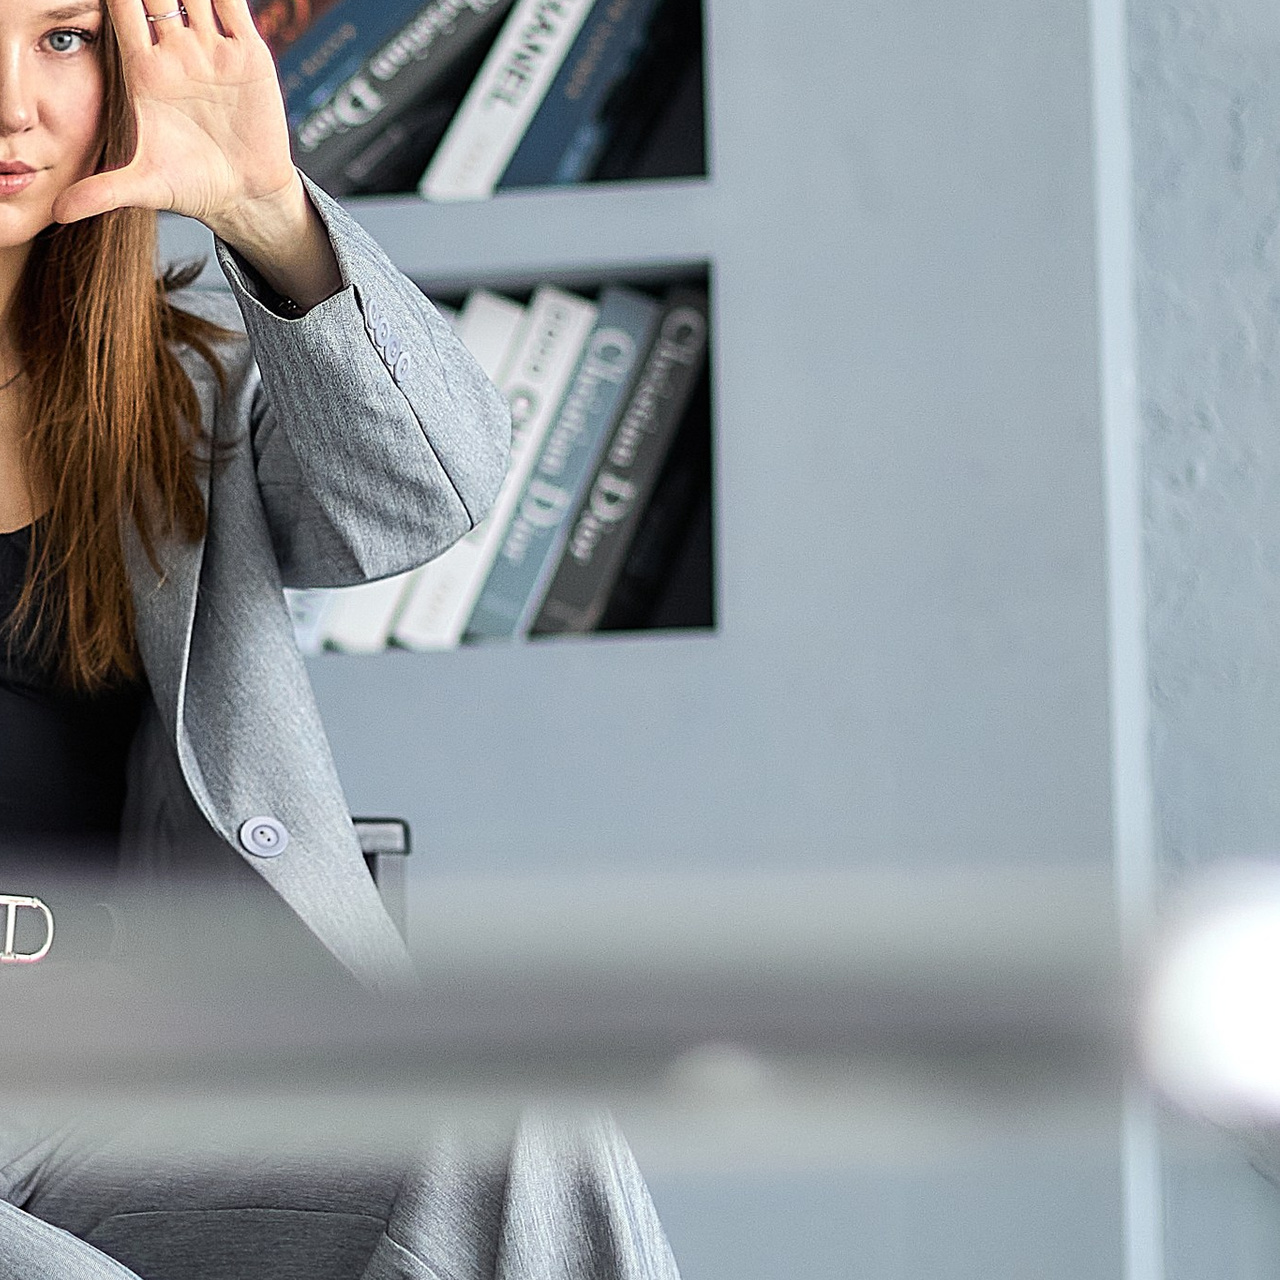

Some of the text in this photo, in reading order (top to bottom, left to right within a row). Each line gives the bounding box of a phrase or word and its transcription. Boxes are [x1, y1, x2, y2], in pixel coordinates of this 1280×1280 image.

[297, 78, 389, 152] Dior
[502, 326, 636, 562] Christian Dior
[570, 306, 708, 562] Christian Dior
